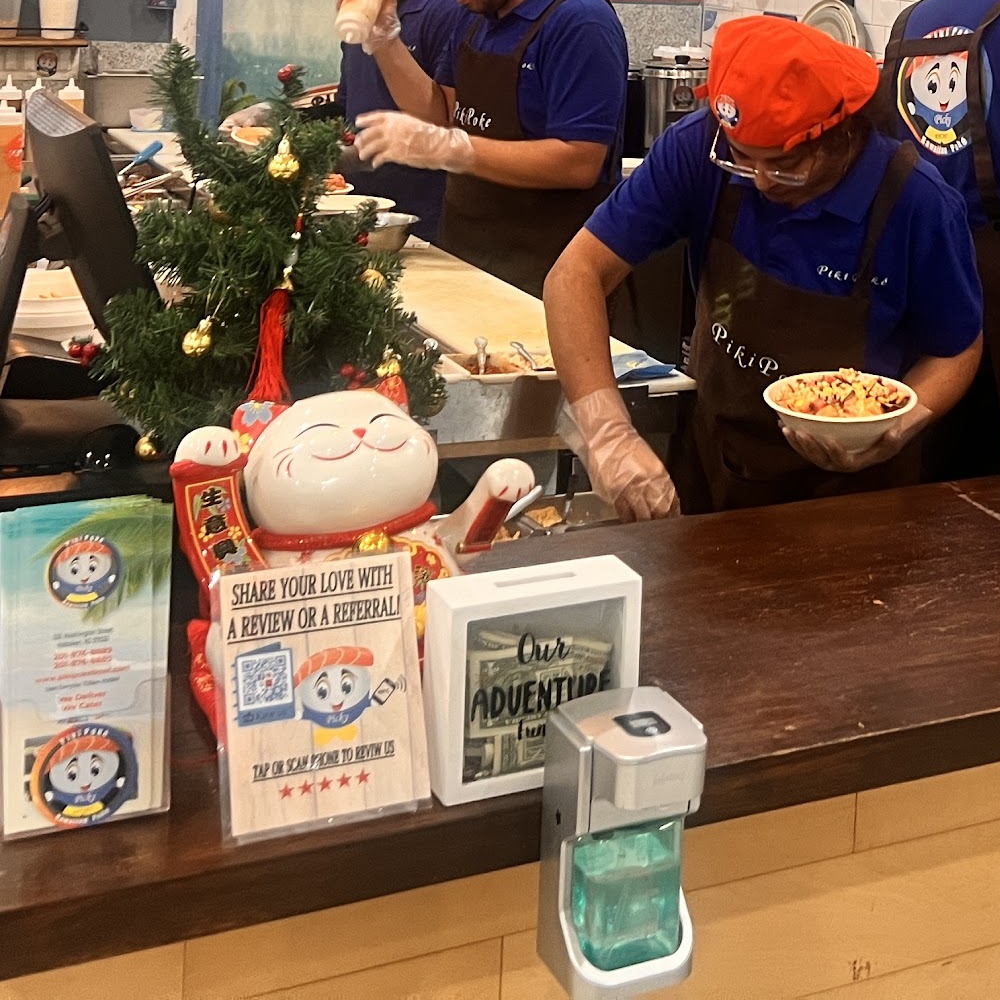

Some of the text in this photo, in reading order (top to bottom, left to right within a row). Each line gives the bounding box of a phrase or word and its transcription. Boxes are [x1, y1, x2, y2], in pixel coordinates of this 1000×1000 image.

[817, 265, 888, 286] Pikike
[232, 564, 393, 606] SHARE YOUR LOVE WITH
[227, 594, 401, 640] A REVIEW OR A REFERRAL!
[518, 632, 570, 664] Our
[253, 740, 395, 777] TAP OR SCAN PHONE TO REVIW US
